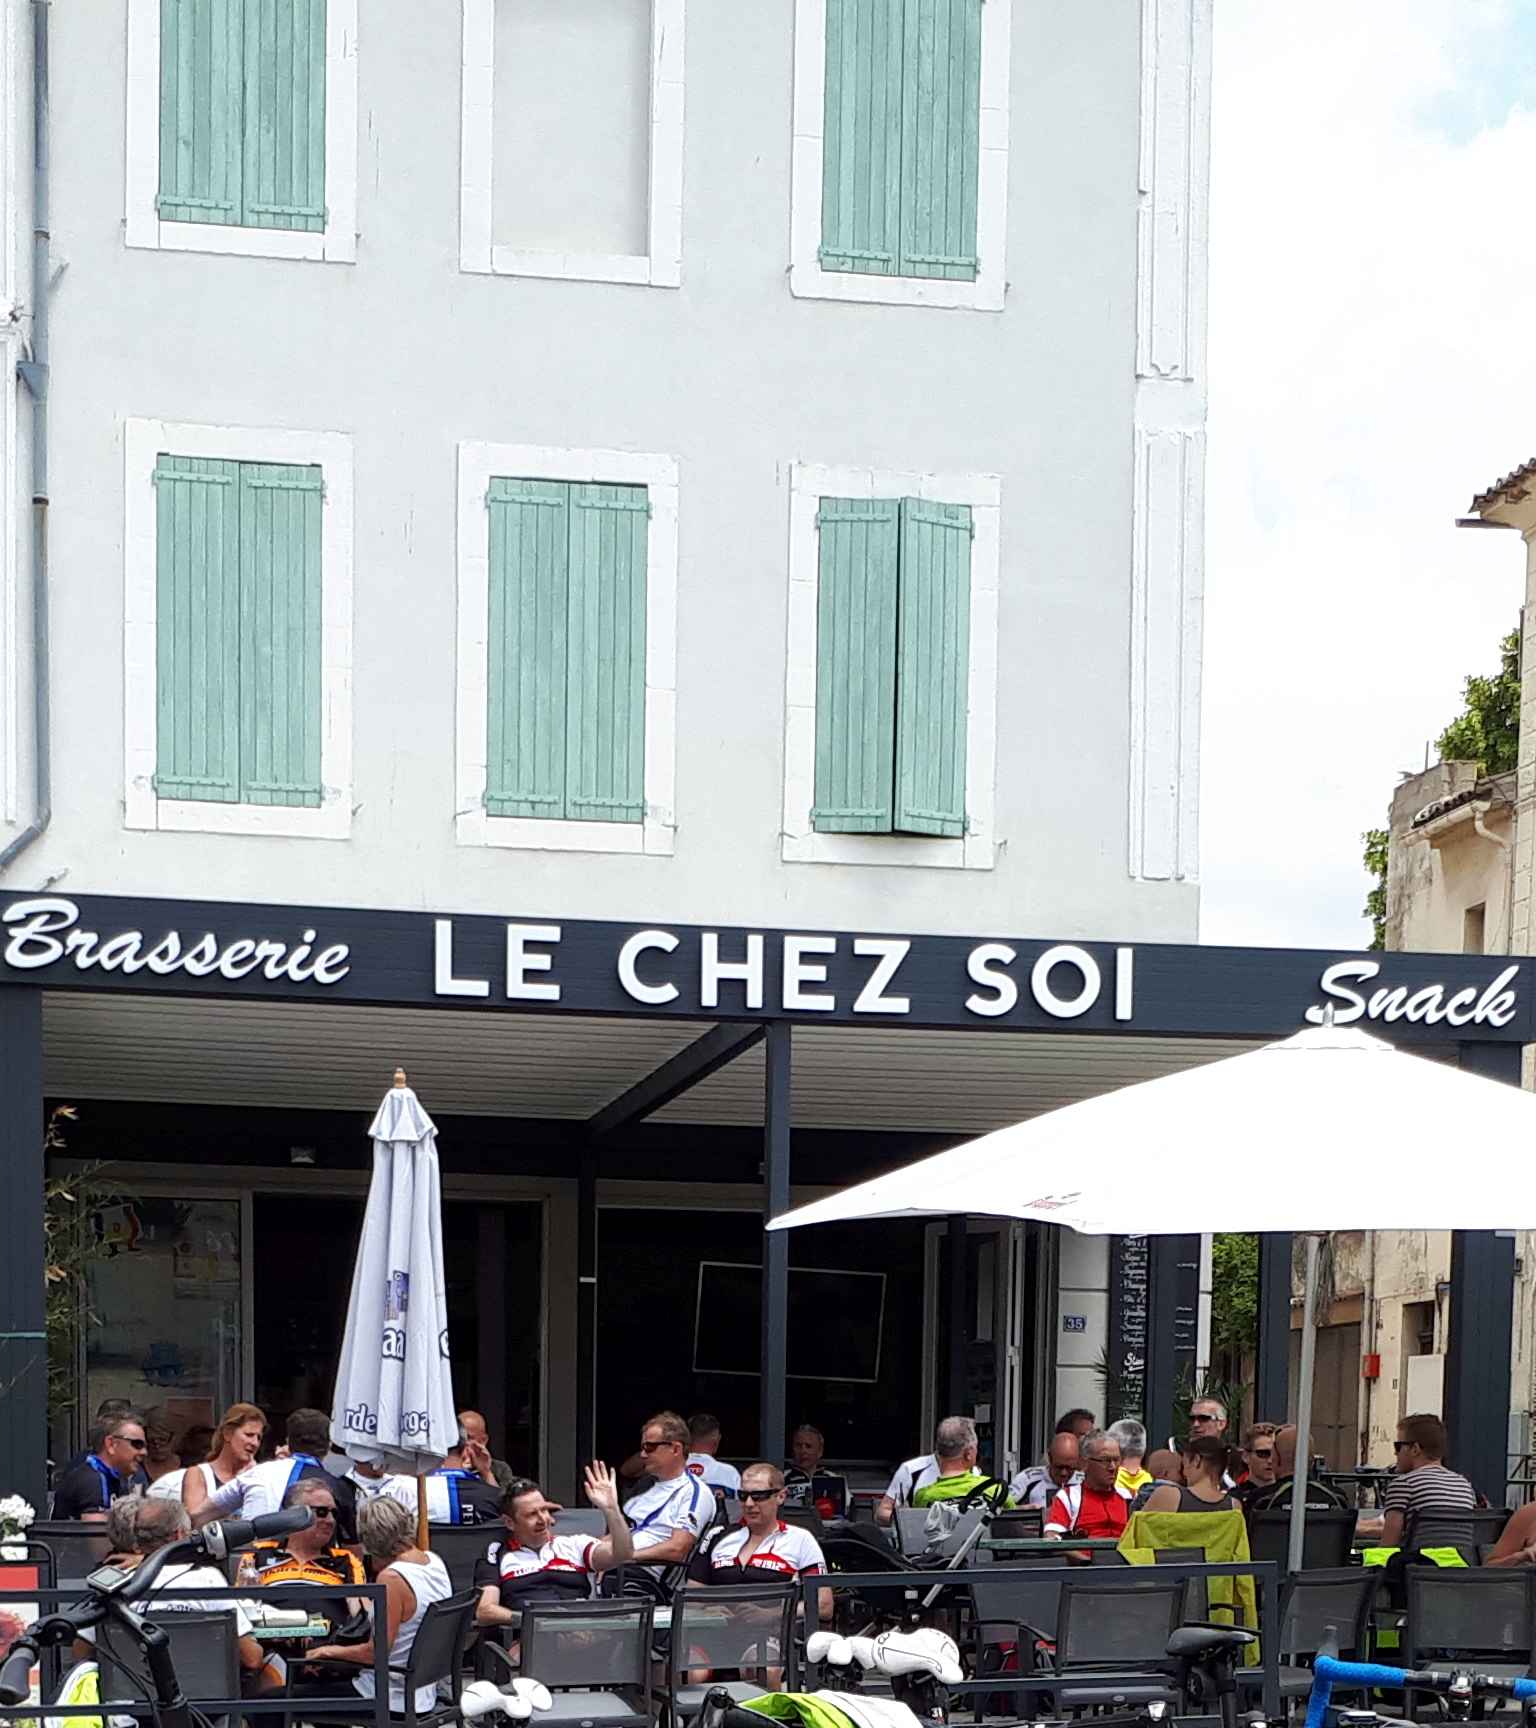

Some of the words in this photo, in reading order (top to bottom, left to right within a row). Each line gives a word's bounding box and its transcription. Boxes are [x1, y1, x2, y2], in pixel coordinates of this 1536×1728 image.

[1, 897, 350, 986] Brasserie
[433, 919, 562, 1000] LE
[616, 929, 911, 1014] CHEZ
[964, 945, 1134, 1020] SOI
[1304, 960, 1521, 1028] Snack
